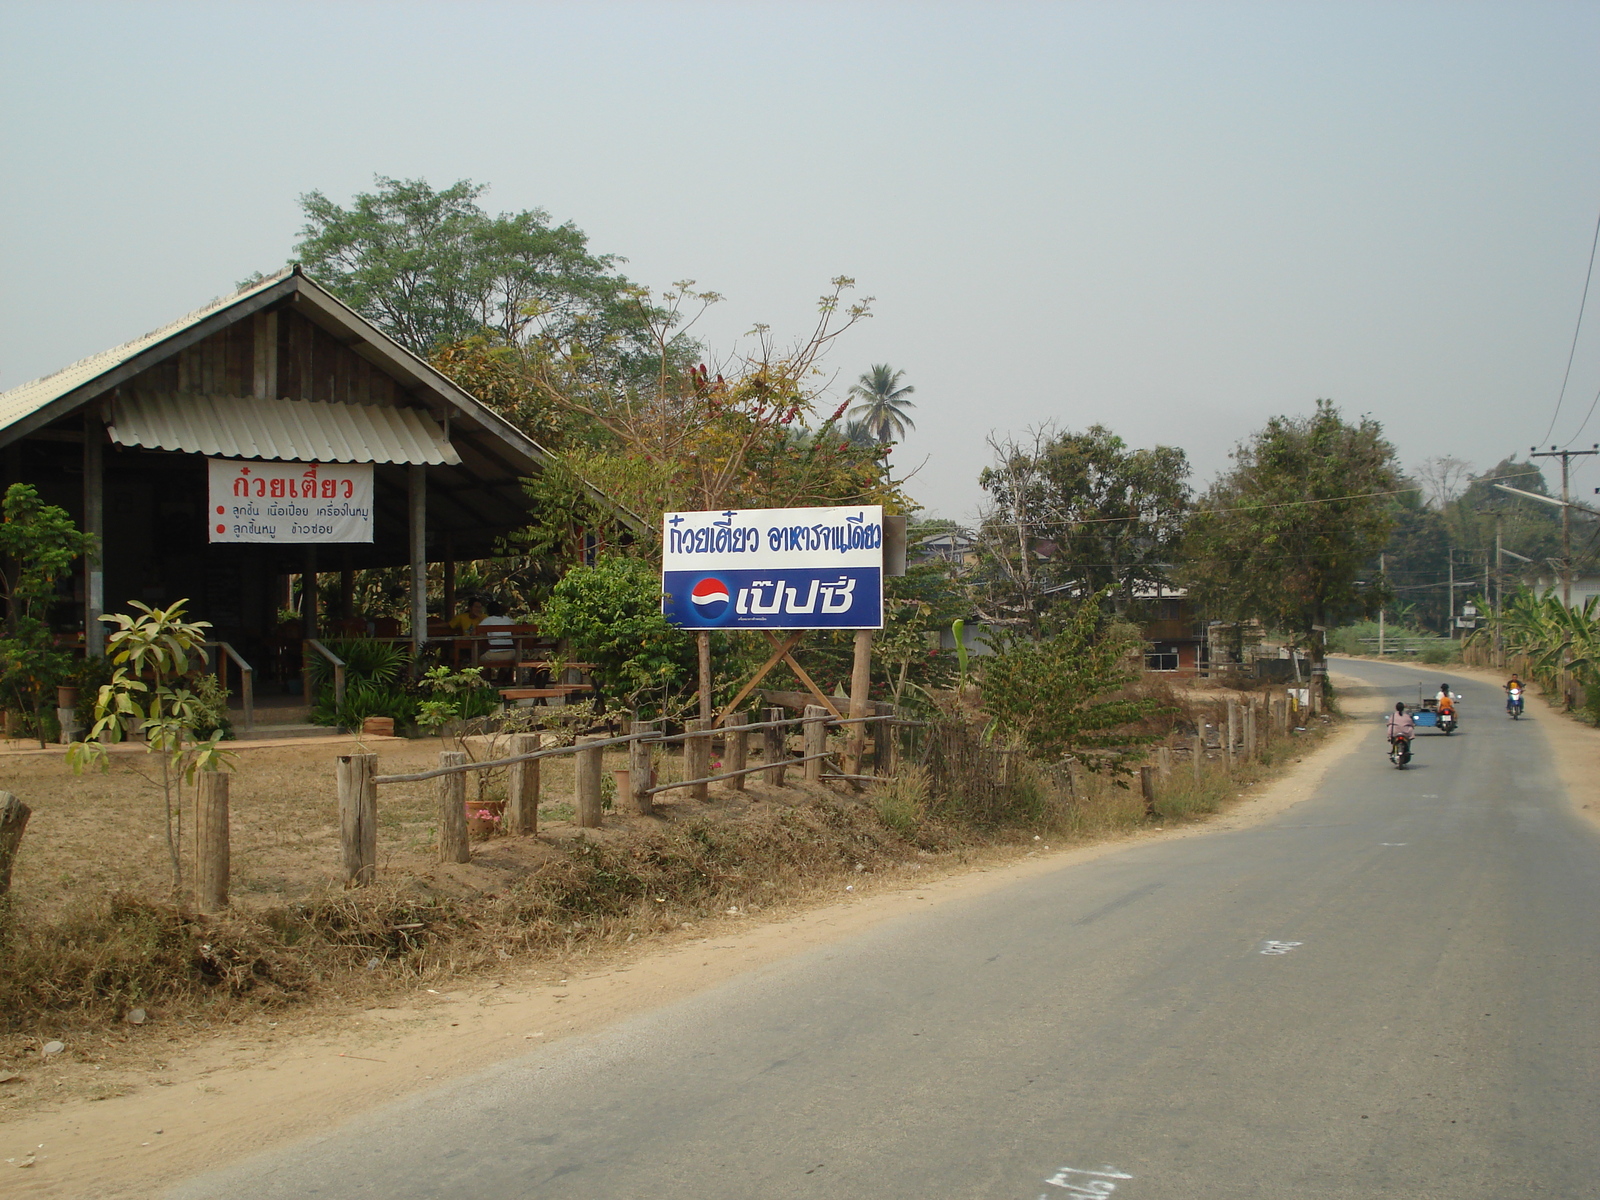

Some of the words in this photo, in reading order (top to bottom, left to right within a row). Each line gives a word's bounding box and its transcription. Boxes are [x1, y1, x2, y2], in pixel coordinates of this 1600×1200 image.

[233, 464, 353, 498] ก๋วยเตี๋ยว
[291, 522, 333, 535] ข้าวซอย
[668, 510, 760, 554] ก๋วยเตี๋ยว
[767, 511, 881, 554] อาหารจานเดียว
[735, 576, 857, 615] เป๊ปซี่
